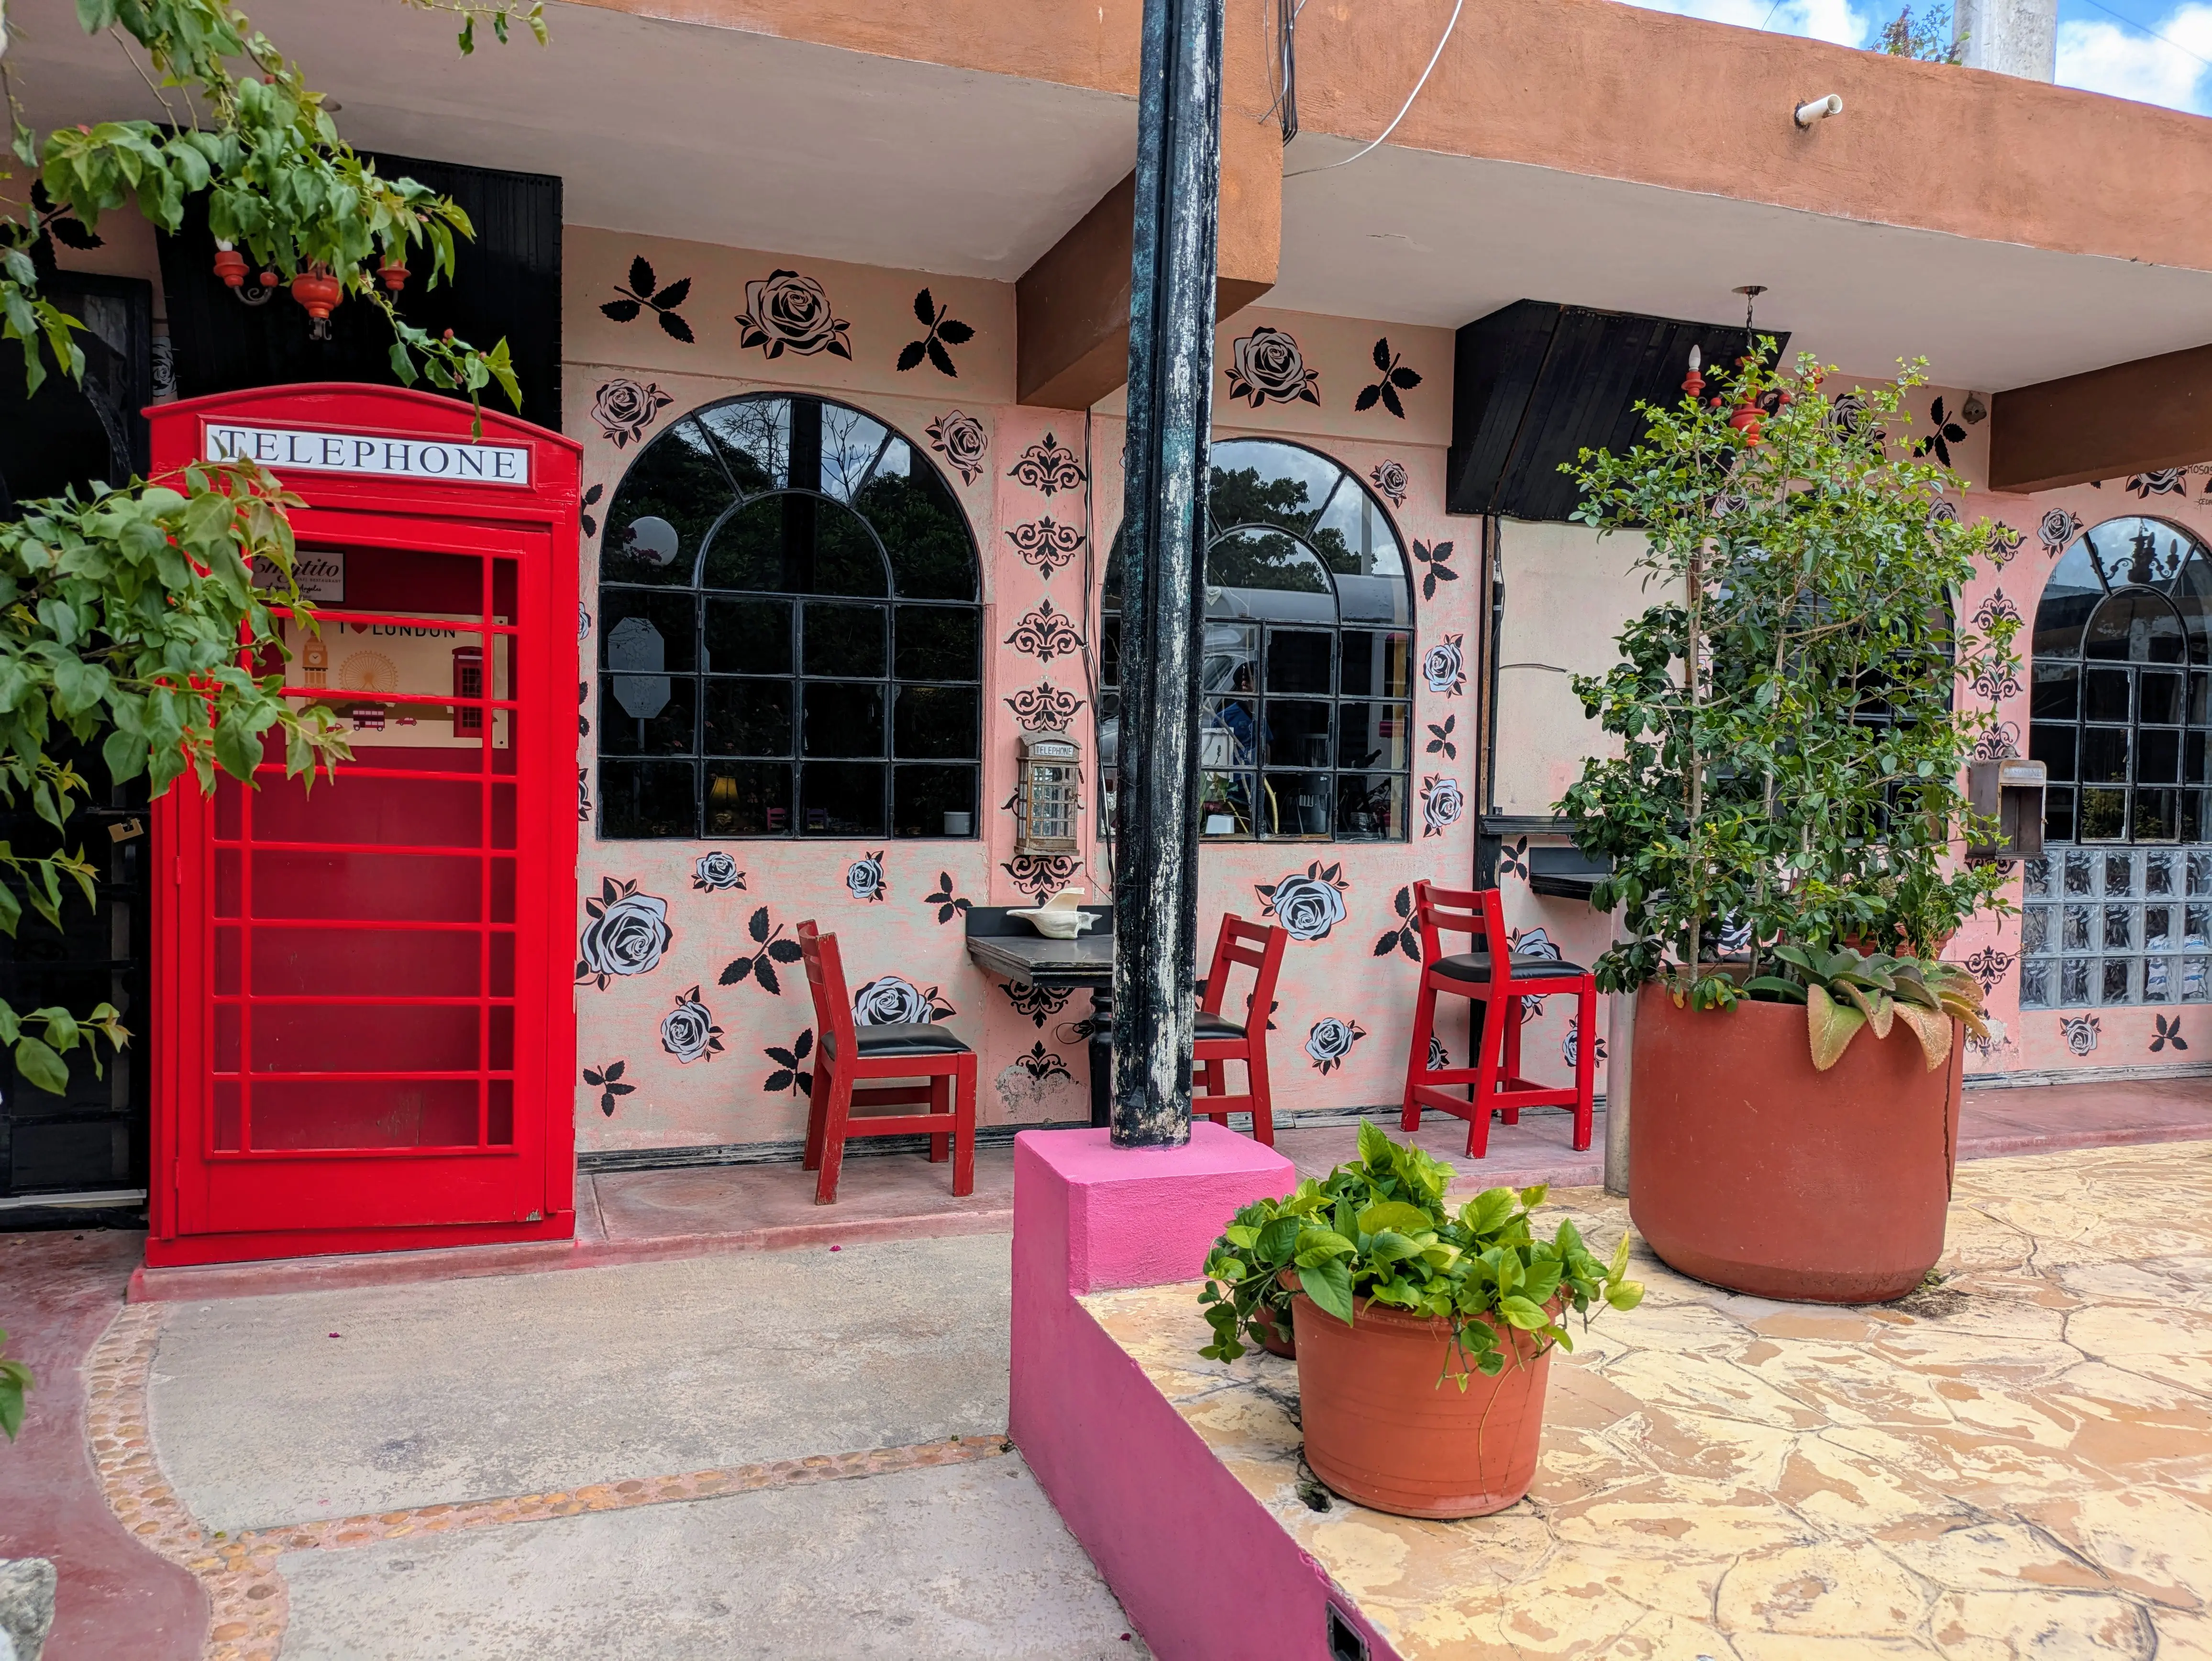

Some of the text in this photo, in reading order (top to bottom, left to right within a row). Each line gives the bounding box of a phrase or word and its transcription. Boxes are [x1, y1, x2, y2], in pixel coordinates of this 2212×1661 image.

[219, 429, 517, 479] TELEPHONE
[341, 621, 455, 638] I LONDON
[1036, 746, 1073, 755] TELEPHONE
